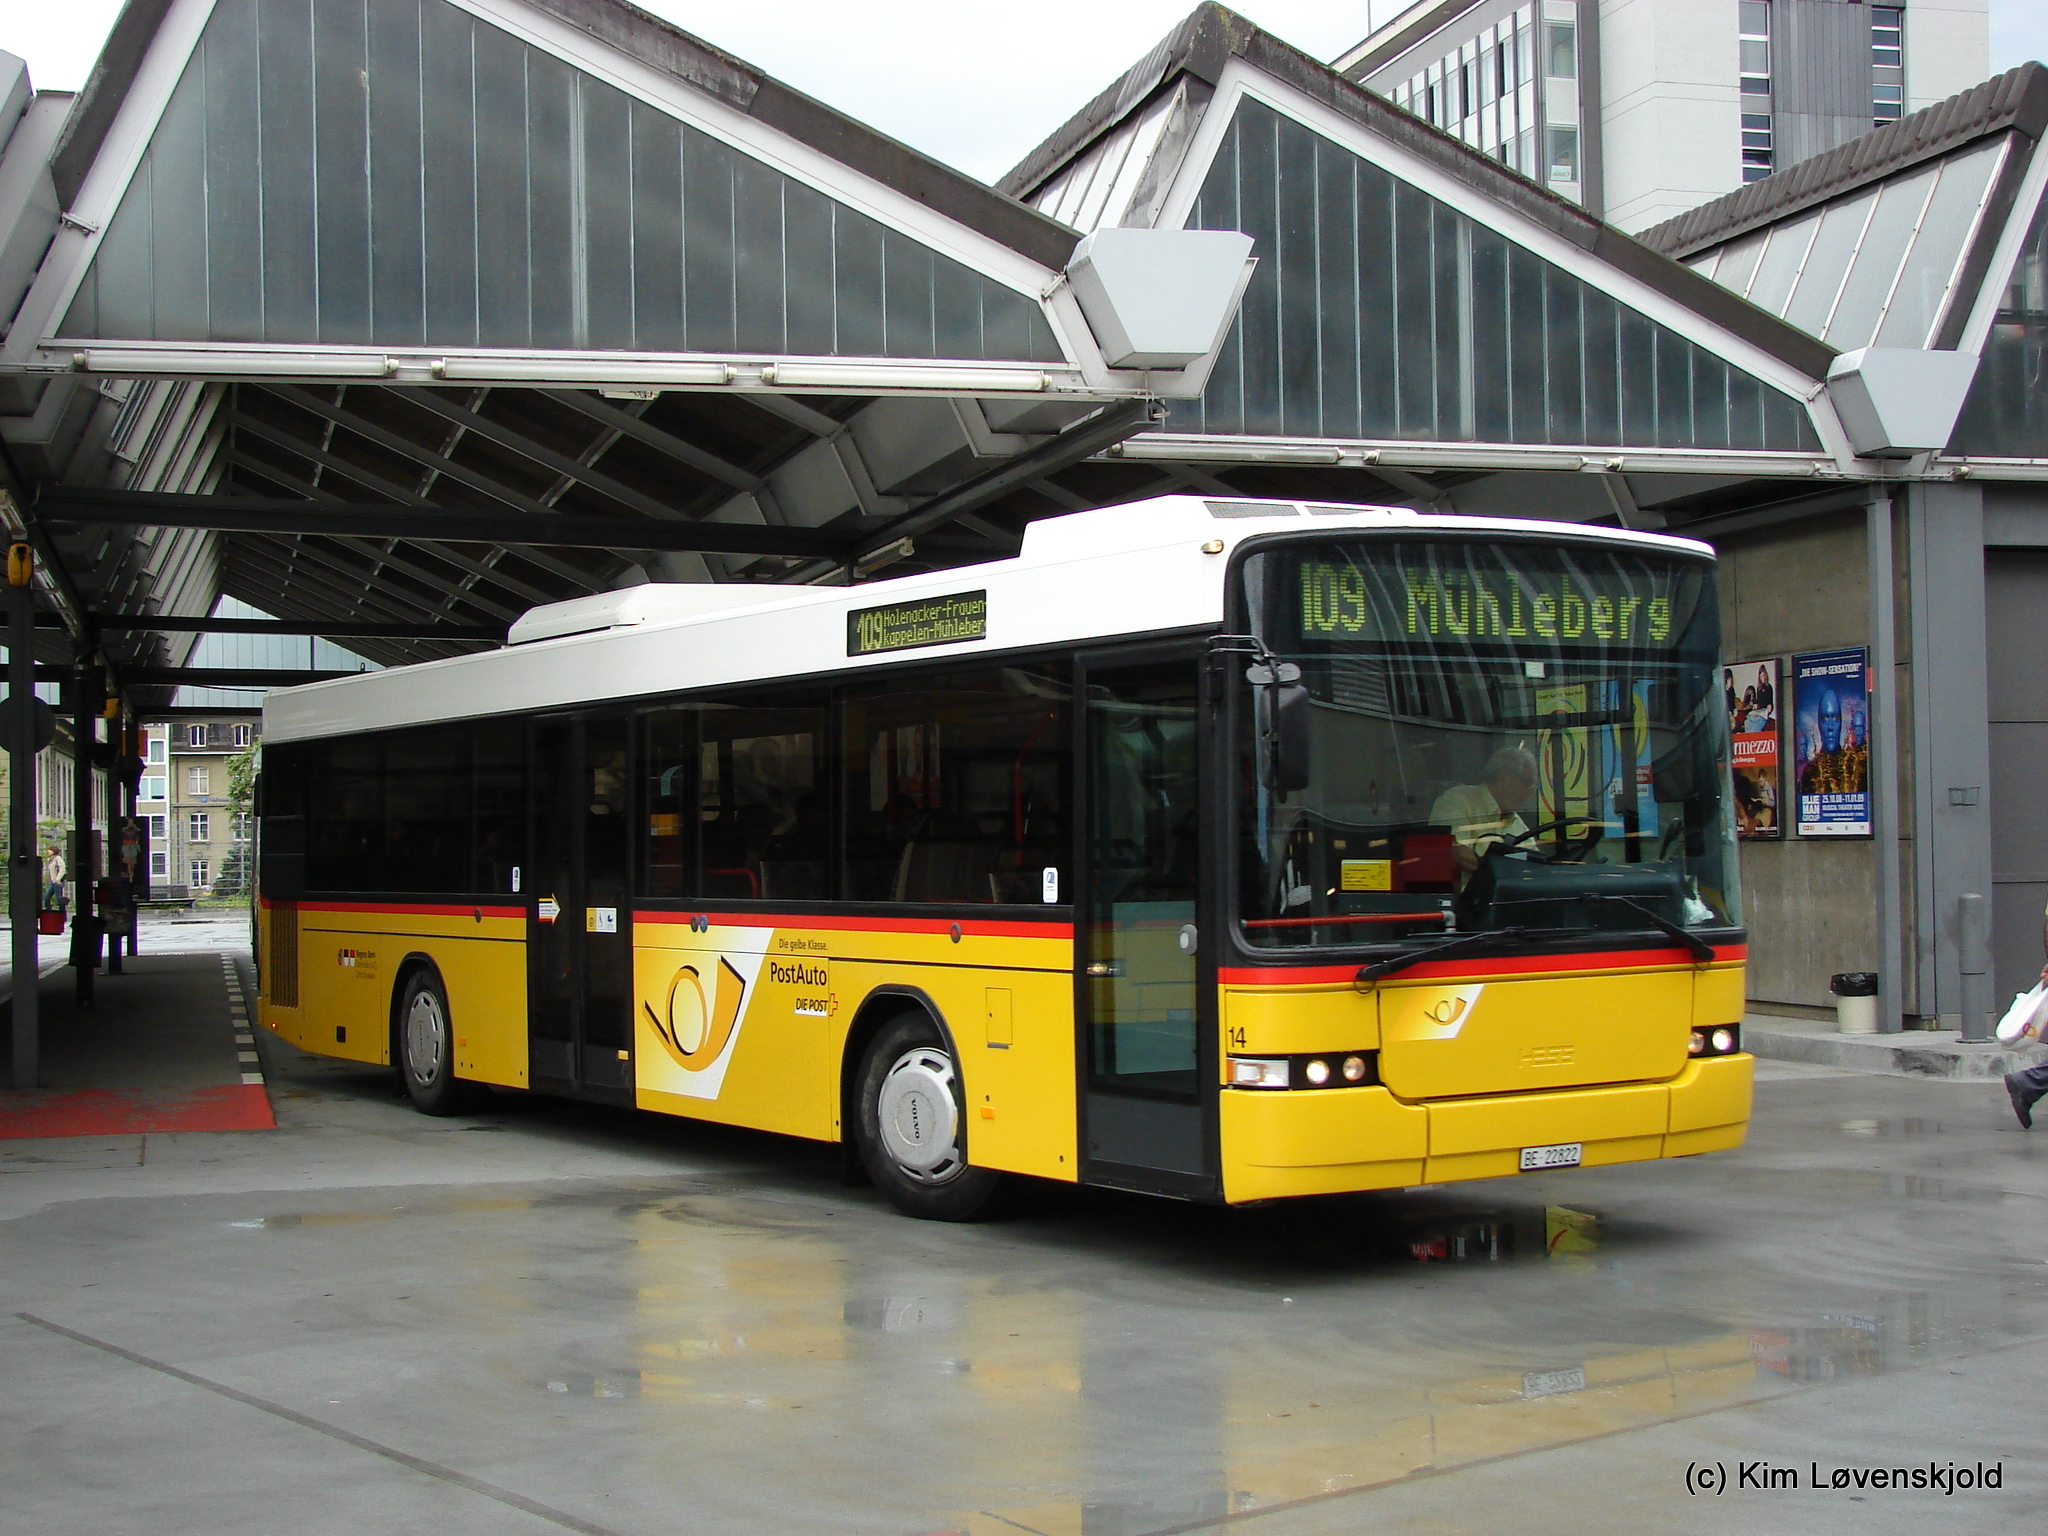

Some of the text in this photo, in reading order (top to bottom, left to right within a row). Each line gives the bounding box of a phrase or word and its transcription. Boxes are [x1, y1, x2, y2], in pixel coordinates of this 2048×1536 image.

[1301, 563, 1671, 640] 109 Mühleberg
[857, 611, 884, 651] 109
[1802, 795, 1820, 804] BLUE
[1802, 804, 1820, 815] MAN
[779, 939, 829, 952] Die gelbe Klasse.
[771, 961, 827, 986] PostAuto
[796, 998, 829, 1012] DIE POST
[1228, 1026, 1247, 1048] 14
[911, 1098, 920, 1139] VOLVO
[1525, 1146, 1579, 1167] BE 22822
